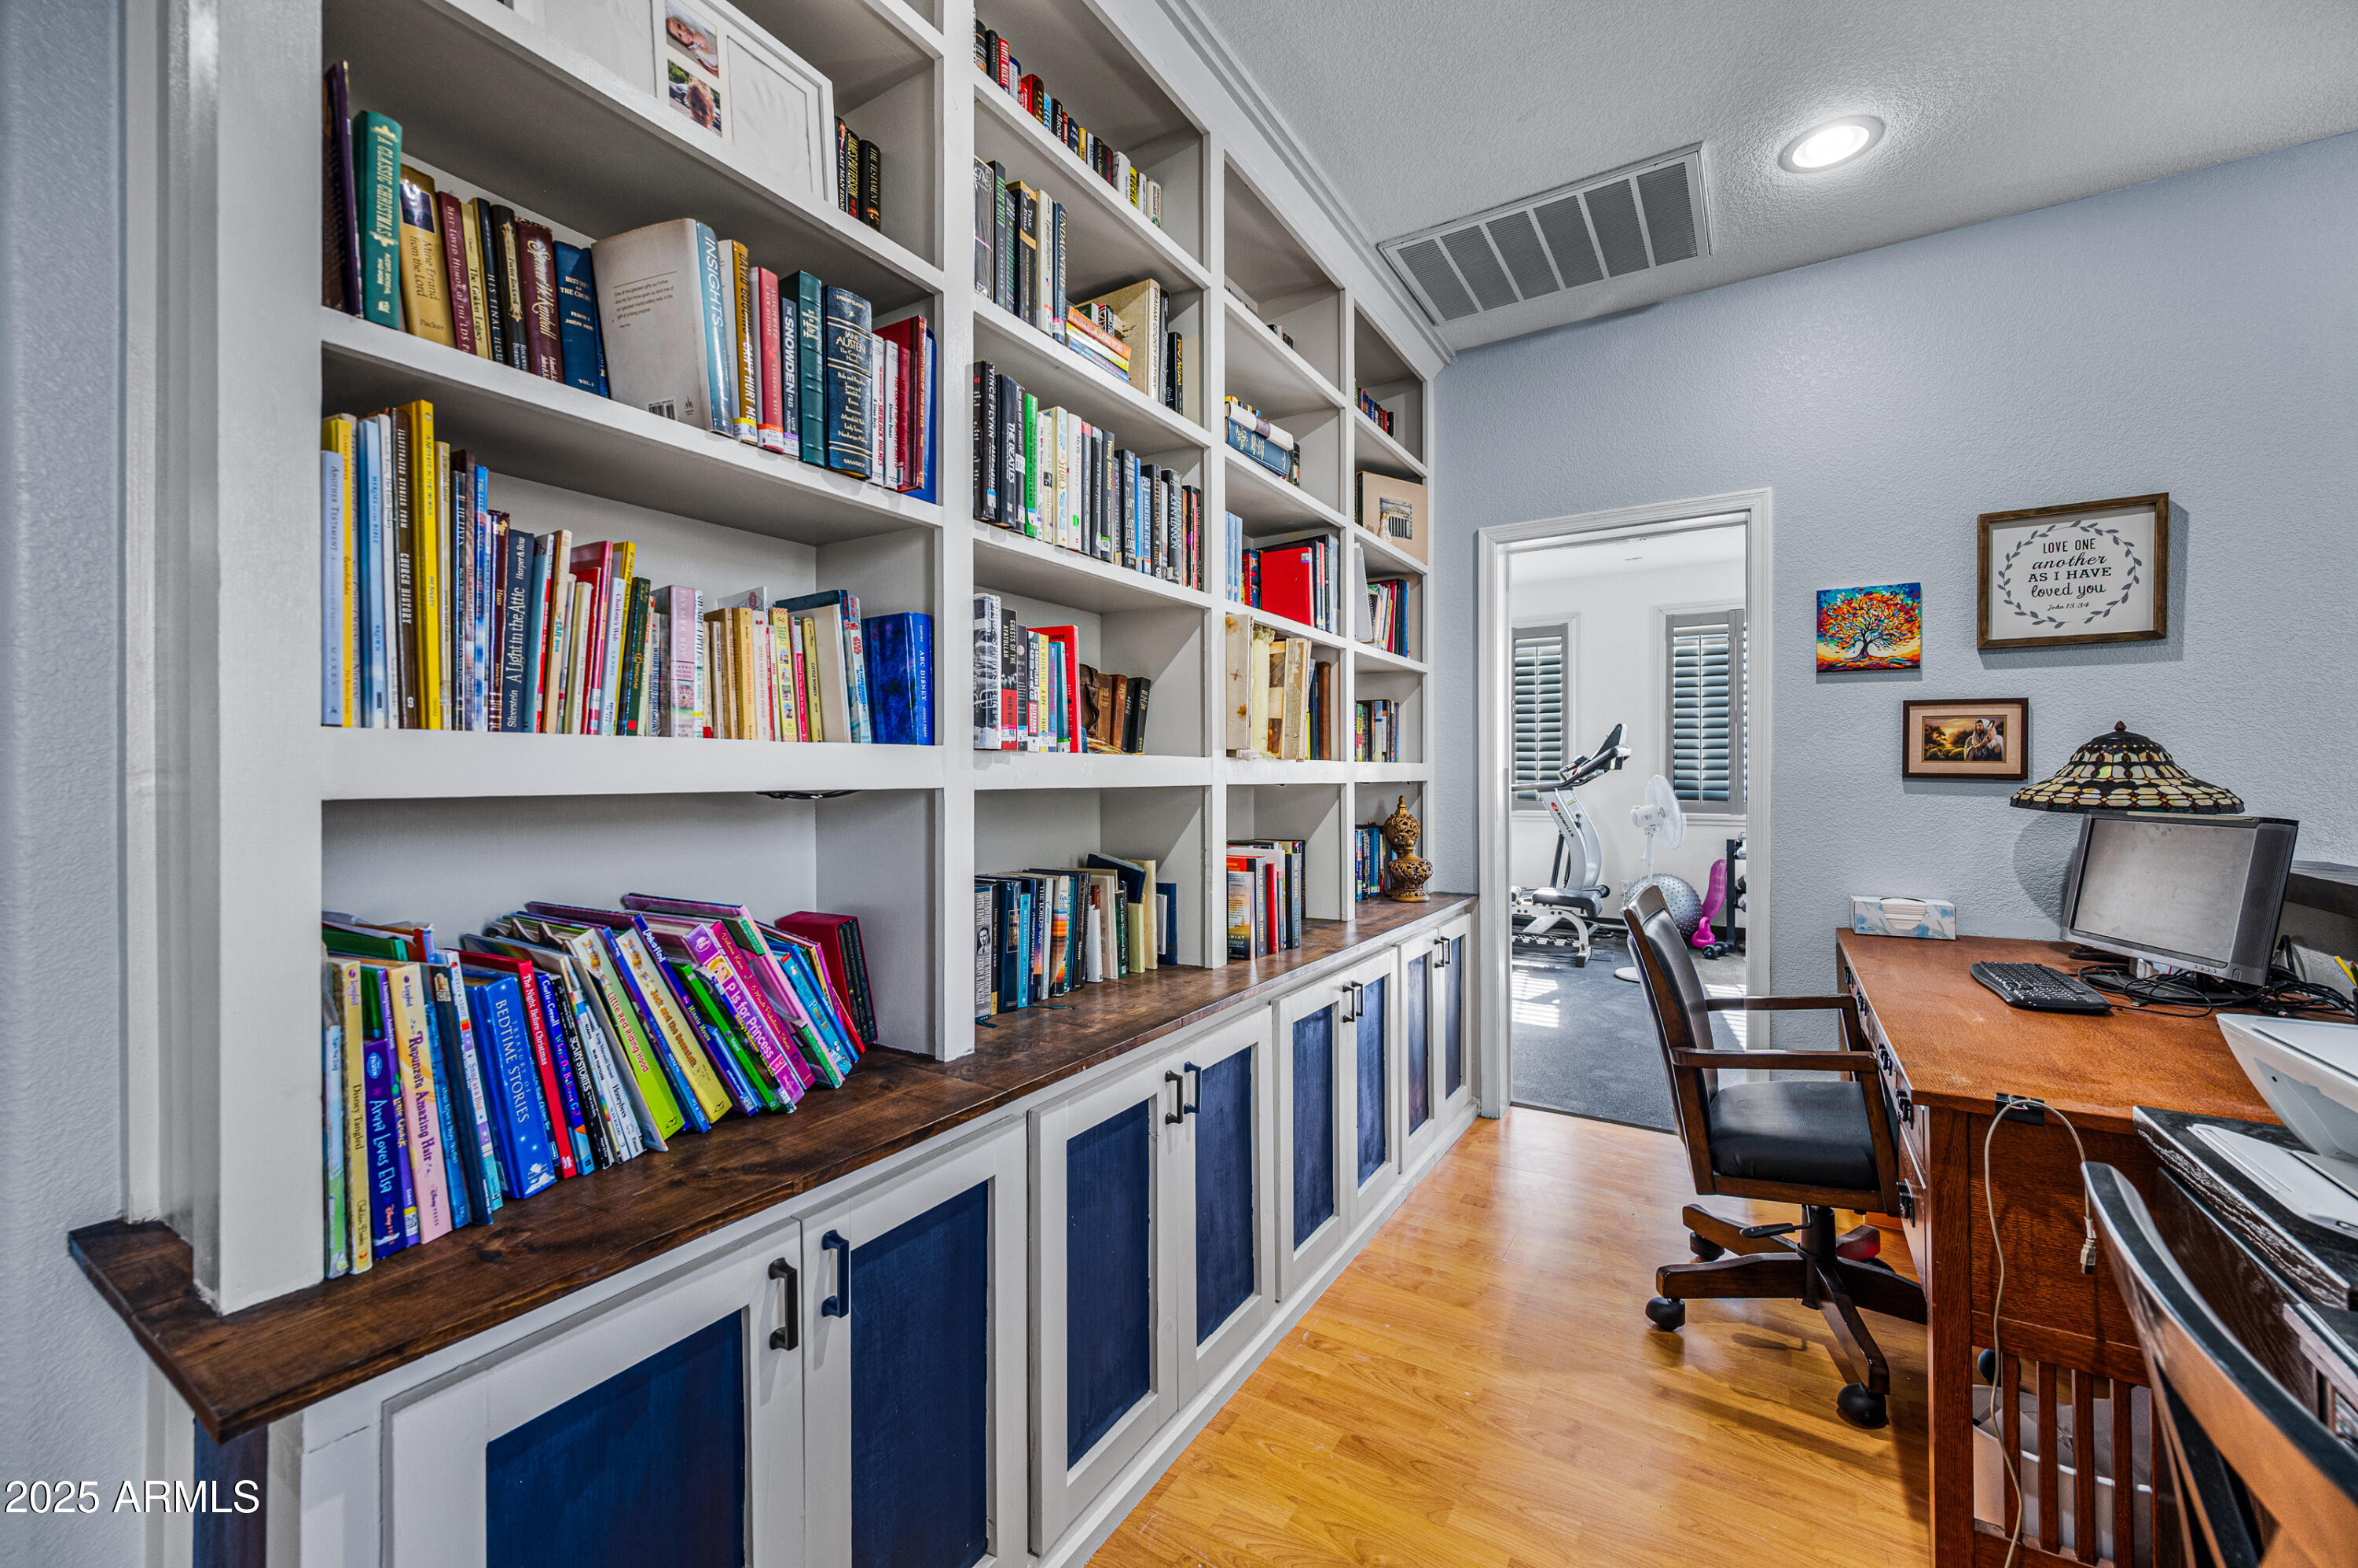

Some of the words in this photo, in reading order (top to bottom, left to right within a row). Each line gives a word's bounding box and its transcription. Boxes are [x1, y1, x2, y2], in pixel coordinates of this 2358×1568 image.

[376, 145, 393, 185] CLASSIC
[376, 183, 393, 238] CHRISTMAS
[410, 236, 421, 256] from
[422, 240, 432, 267] Mine
[704, 236, 723, 327] INSIGHTS
[739, 252, 749, 285] DAVID
[414, 274, 428, 298] Lord
[426, 268, 441, 302] Errand
[487, 274, 497, 293] HIS
[560, 286, 574, 296] THE
[490, 299, 501, 330] FINAL
[836, 336, 866, 354] AUSTEN
[845, 331, 860, 341] JANE
[784, 315, 797, 395] SNOWDEN
[744, 375, 755, 406] HURT
[398, 428, 406, 475] ILLUSTRATED
[1008, 436, 1016, 484] BEATLES
[399, 477, 408, 506] STORIES
[516, 536, 526, 550] Row
[2043, 541, 2069, 554] LOVE
[2075, 538, 2096, 551] ONE
[399, 553, 410, 584] CHURCH
[516, 558, 525, 580] Harper
[2027, 572, 2048, 583] AS
[2054, 571, 2059, 581] I
[2066, 567, 2112, 580] HAVE
[2032, 552, 2107, 570] another
[400, 588, 412, 623] HISTORY
[509, 587, 526, 615] Attic
[2031, 582, 2073, 598] loved
[2076, 584, 2107, 600] you
[613, 593, 622, 627] Charlotte's
[678, 589, 687, 631] FARMER
[2047, 603, 2064, 611] John
[612, 628, 621, 641] Web
[678, 635, 687, 657] BOY
[507, 641, 525, 670] Light
[506, 672, 522, 684] A
[507, 689, 519, 728] Silverstein
[1557, 812, 1575, 838] BOWFLEX
[523, 973, 532, 989] The
[526, 988, 535, 1008] Night
[607, 990, 620, 1013] Little
[530, 1008, 541, 1030] Before
[618, 1011, 629, 1030] Red
[649, 988, 663, 1008] Jack
[659, 1005, 672, 1023] and
[667, 1019, 678, 1035] the
[674, 1031, 697, 1068] Beanstalk
[687, 1003, 701, 1025] Minnie
[697, 1023, 711, 1042] Mouse
[725, 983, 736, 993] P
[731, 992, 740, 1004] Is
[736, 1002, 751, 1018] for
[746, 1016, 774, 1059] Princess
[534, 1030, 548, 1066] Christmas
[623, 1026, 641, 1055] Riding
[495, 999, 516, 1064] BEDTIME
[509, 1064, 530, 1124] STORIES
[569, 1036, 582, 1060] SCARY
[576, 1059, 592, 1092] STORIES
[635, 1051, 650, 1074] Hood
[353, 1083, 363, 1113] Disney
[612, 1083, 627, 1118] Honeybees
[369, 1100, 389, 1133] Anna
[416, 1089, 430, 1139] Amazing
[353, 1115, 365, 1151] Tangled
[373, 1133, 392, 1166] Loves
[422, 1137, 435, 1162] Hair
[379, 1166, 397, 1194] Elsa
